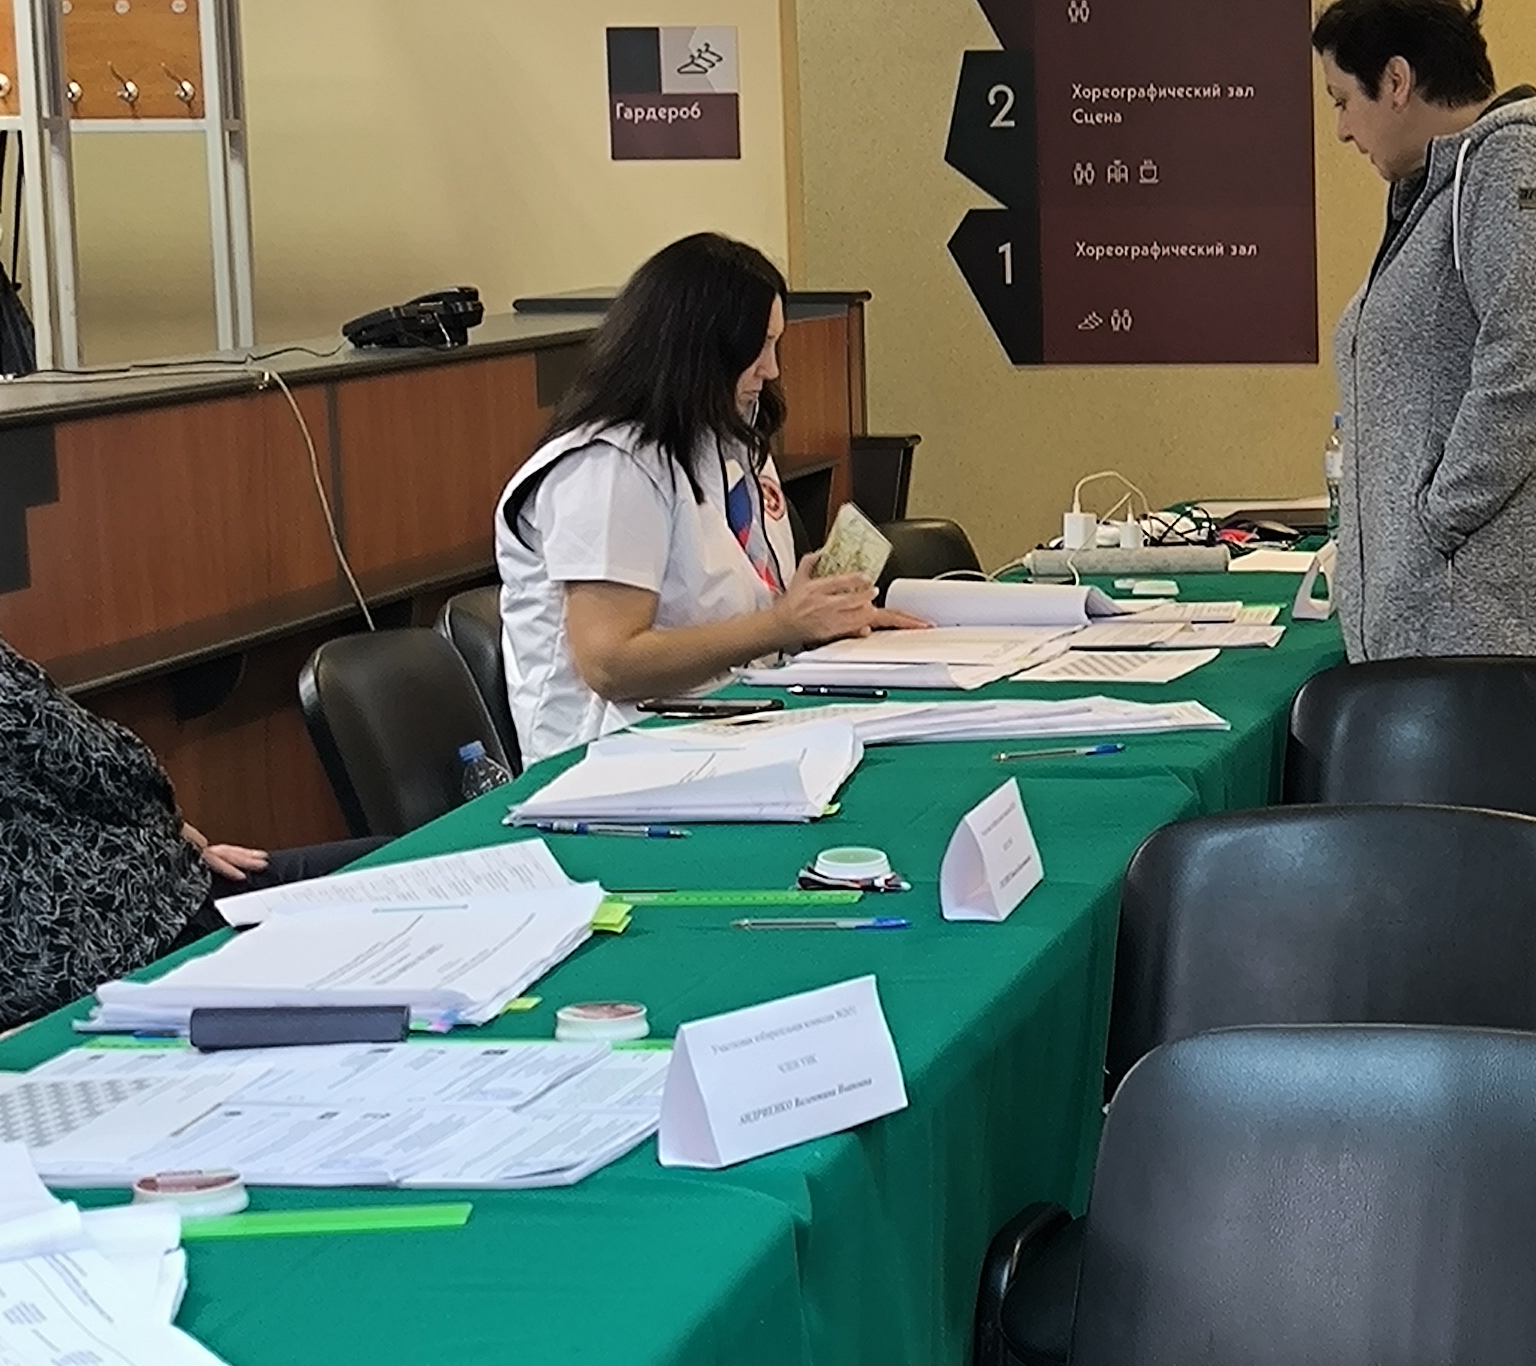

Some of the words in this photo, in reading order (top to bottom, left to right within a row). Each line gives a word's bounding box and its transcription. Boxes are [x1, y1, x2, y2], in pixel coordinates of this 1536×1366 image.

[1072, 83, 1221, 103] Хореографический
[1227, 86, 1254, 98] зал
[616, 101, 701, 125] Гардероб
[987, 84, 1016, 128] 2
[1072, 108, 1122, 125] Сцена
[1076, 241, 1224, 261] Хореографический
[1230, 244, 1257, 256] зал
[998, 242, 1012, 285] 1
